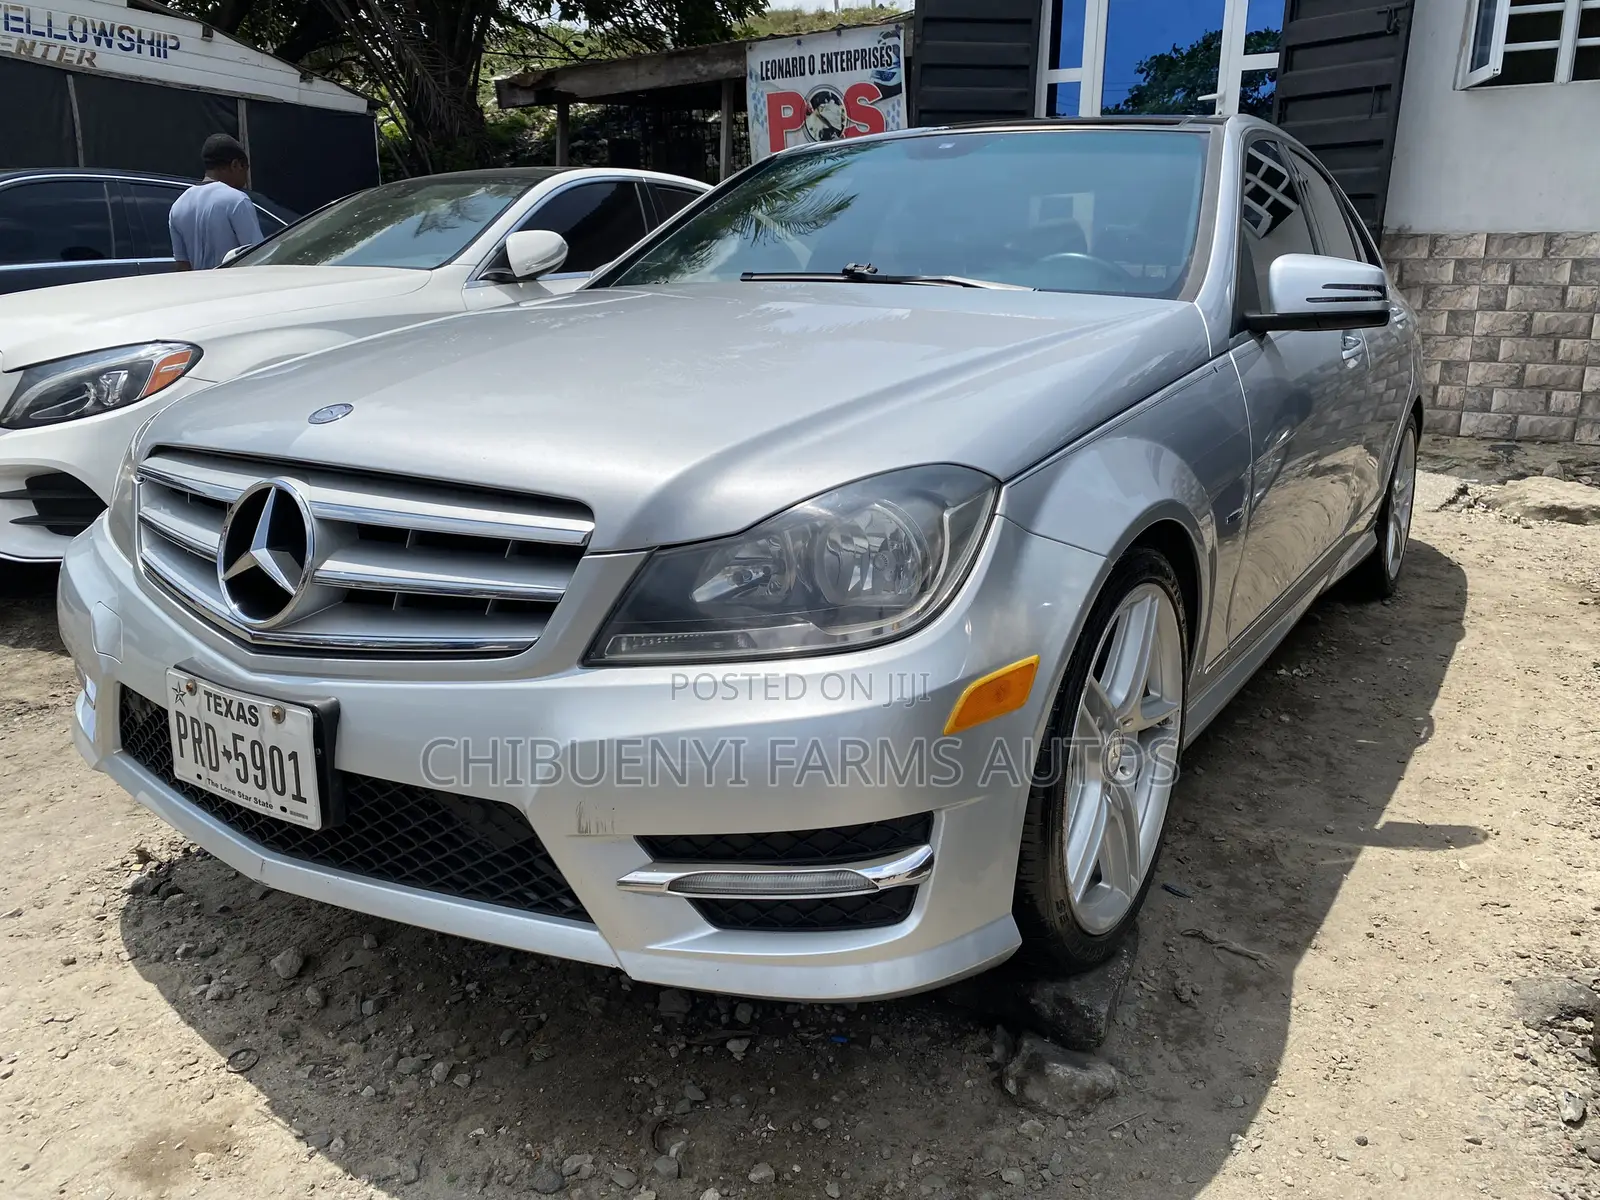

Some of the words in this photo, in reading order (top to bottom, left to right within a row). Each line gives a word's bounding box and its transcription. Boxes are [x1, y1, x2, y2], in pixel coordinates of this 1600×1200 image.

[0, 3, 180, 59] ELLOWSHIP
[760, 54, 806, 81] LEONARD
[766, 82, 887, 152] POS
[203, 690, 259, 727] TEXAS
[206, 778, 219, 789] The
[220, 783, 236, 796] Lone
[237, 790, 252, 802] Star
[253, 795, 274, 810] State
